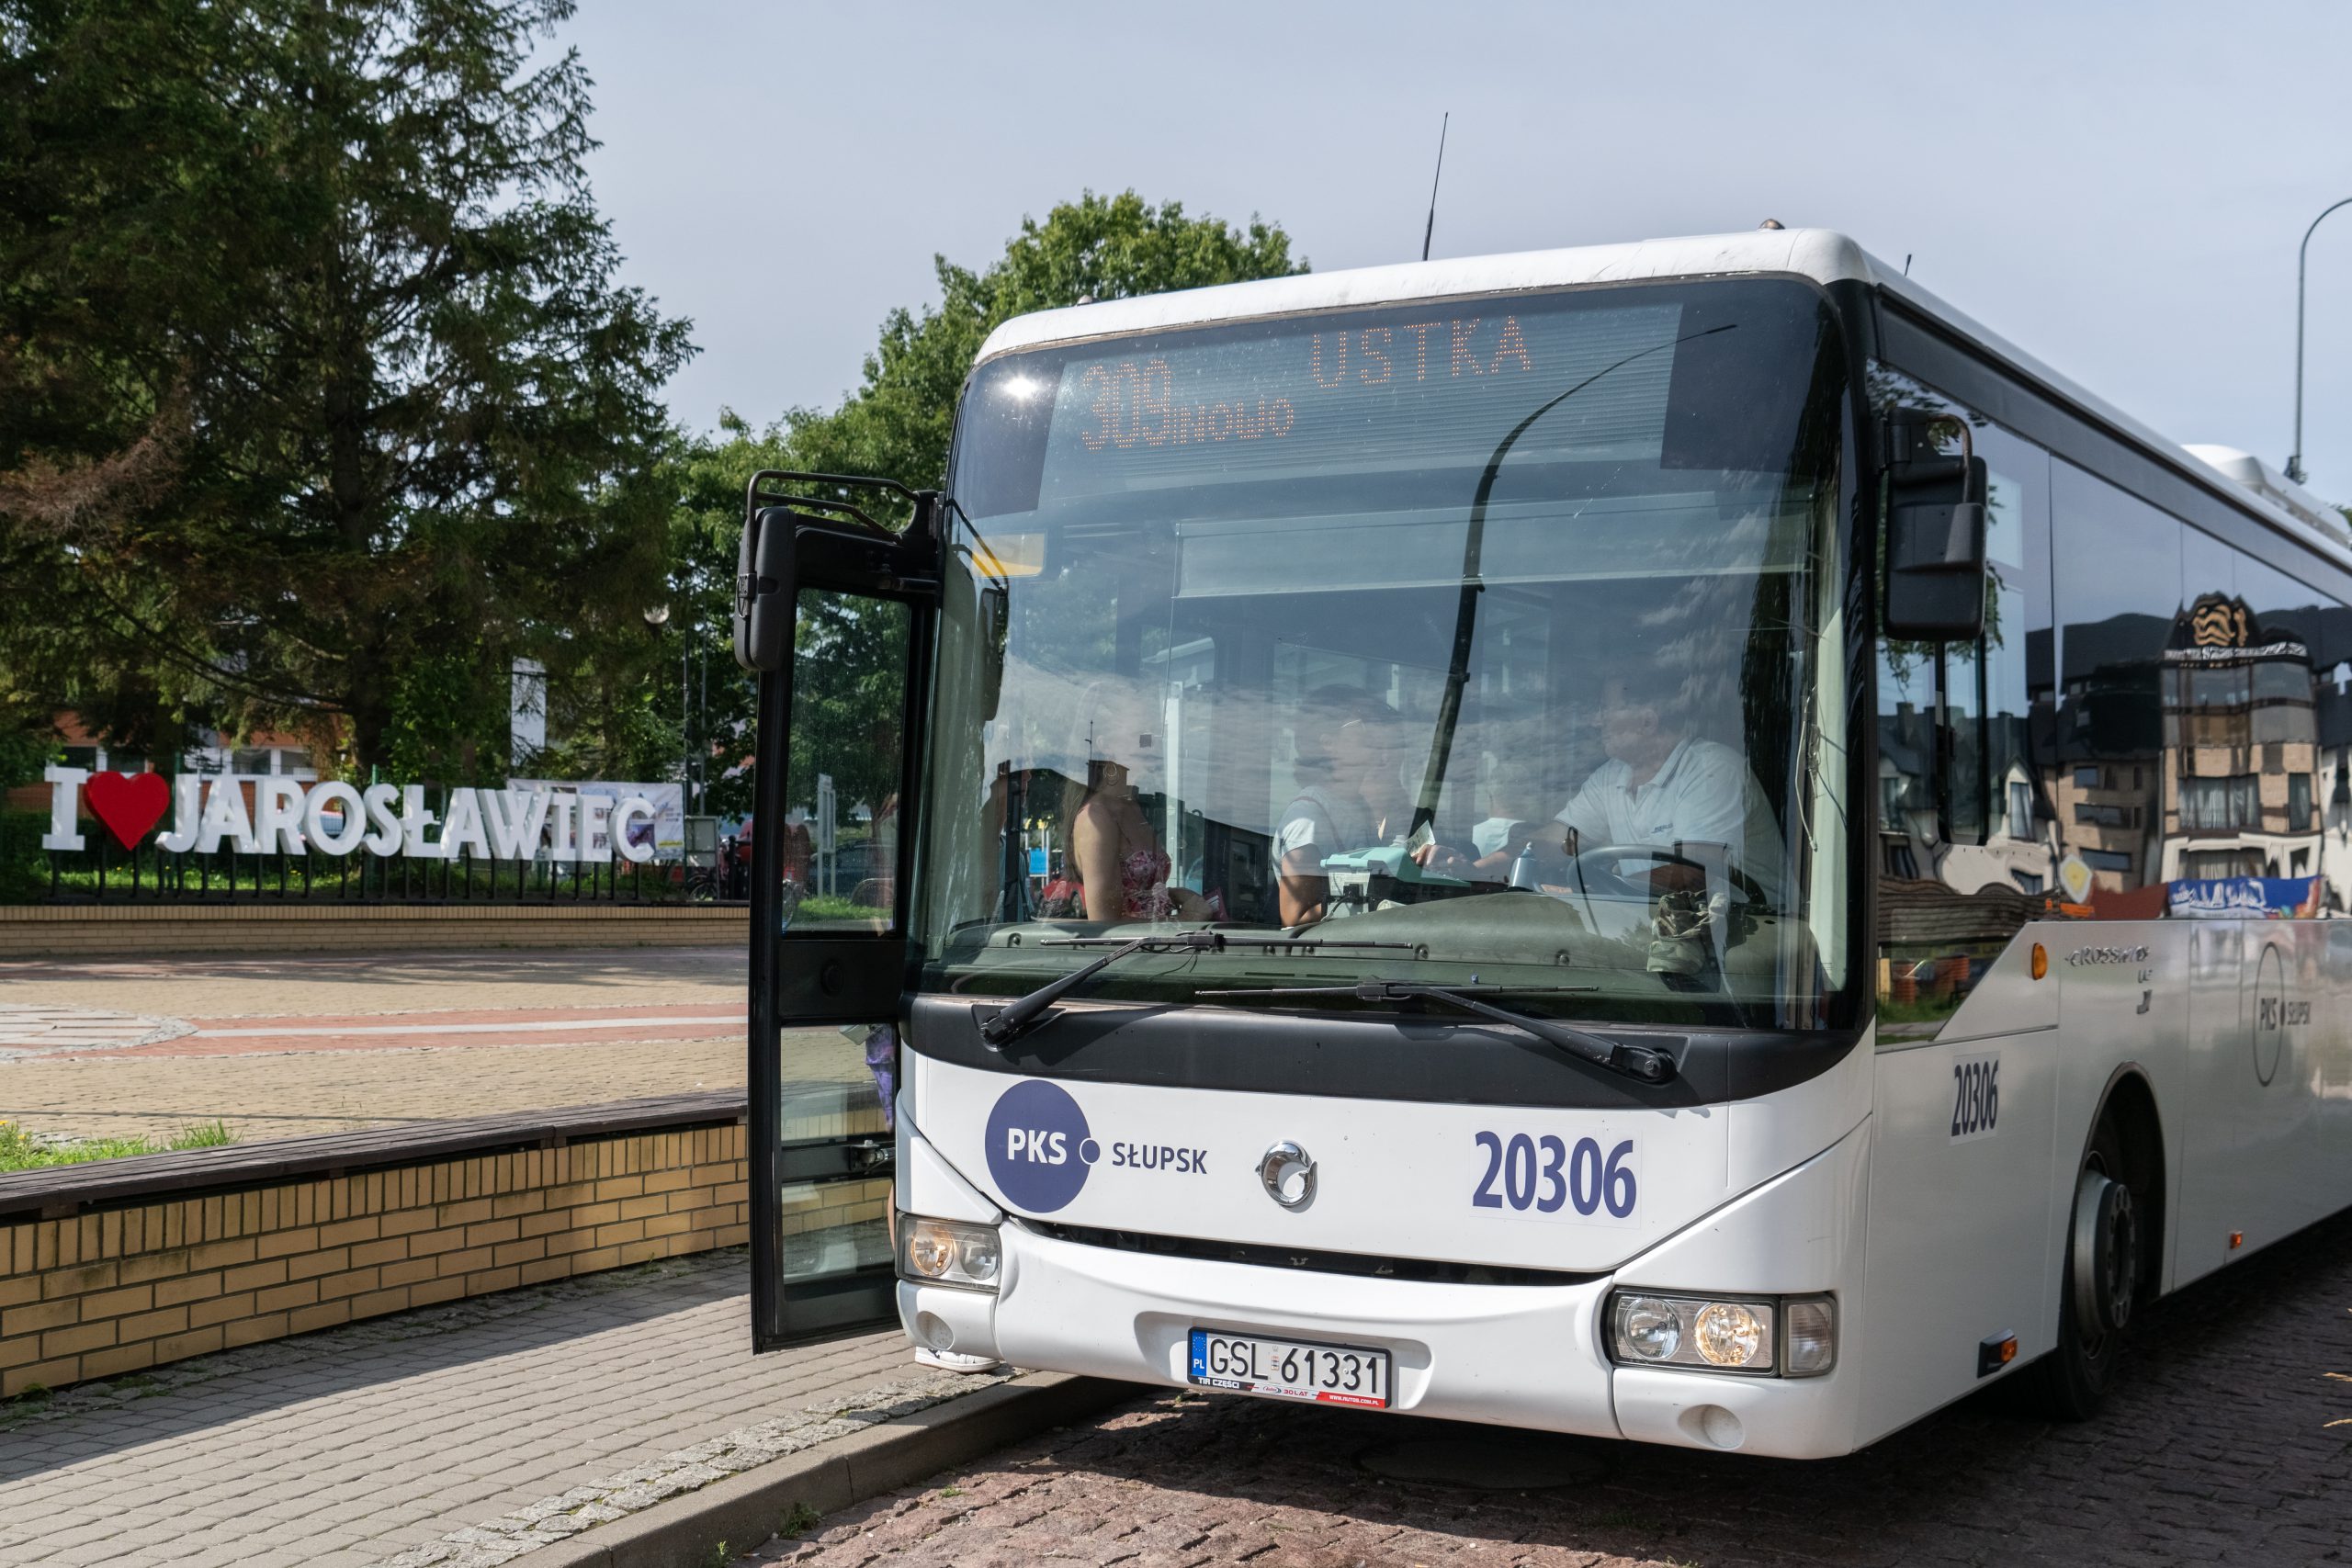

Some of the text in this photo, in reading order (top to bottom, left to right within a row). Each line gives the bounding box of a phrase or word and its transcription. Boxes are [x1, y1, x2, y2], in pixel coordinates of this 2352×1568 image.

[1312, 315, 1532, 389] USTKA
[1081, 359, 1172, 450] 309
[42, 766, 657, 864] I JAROSŁAWIEC
[1951, 1059, 1999, 1137] 20306
[1007, 1127, 1208, 1175] PKS SŁUPSK
[1472, 1130, 1637, 1219] 20306
[1193, 1359, 1205, 1370] PL
[1197, 1377, 1240, 1390] TIR CZĘŚCI
[1209, 1337, 1377, 1394] GSL 61331
